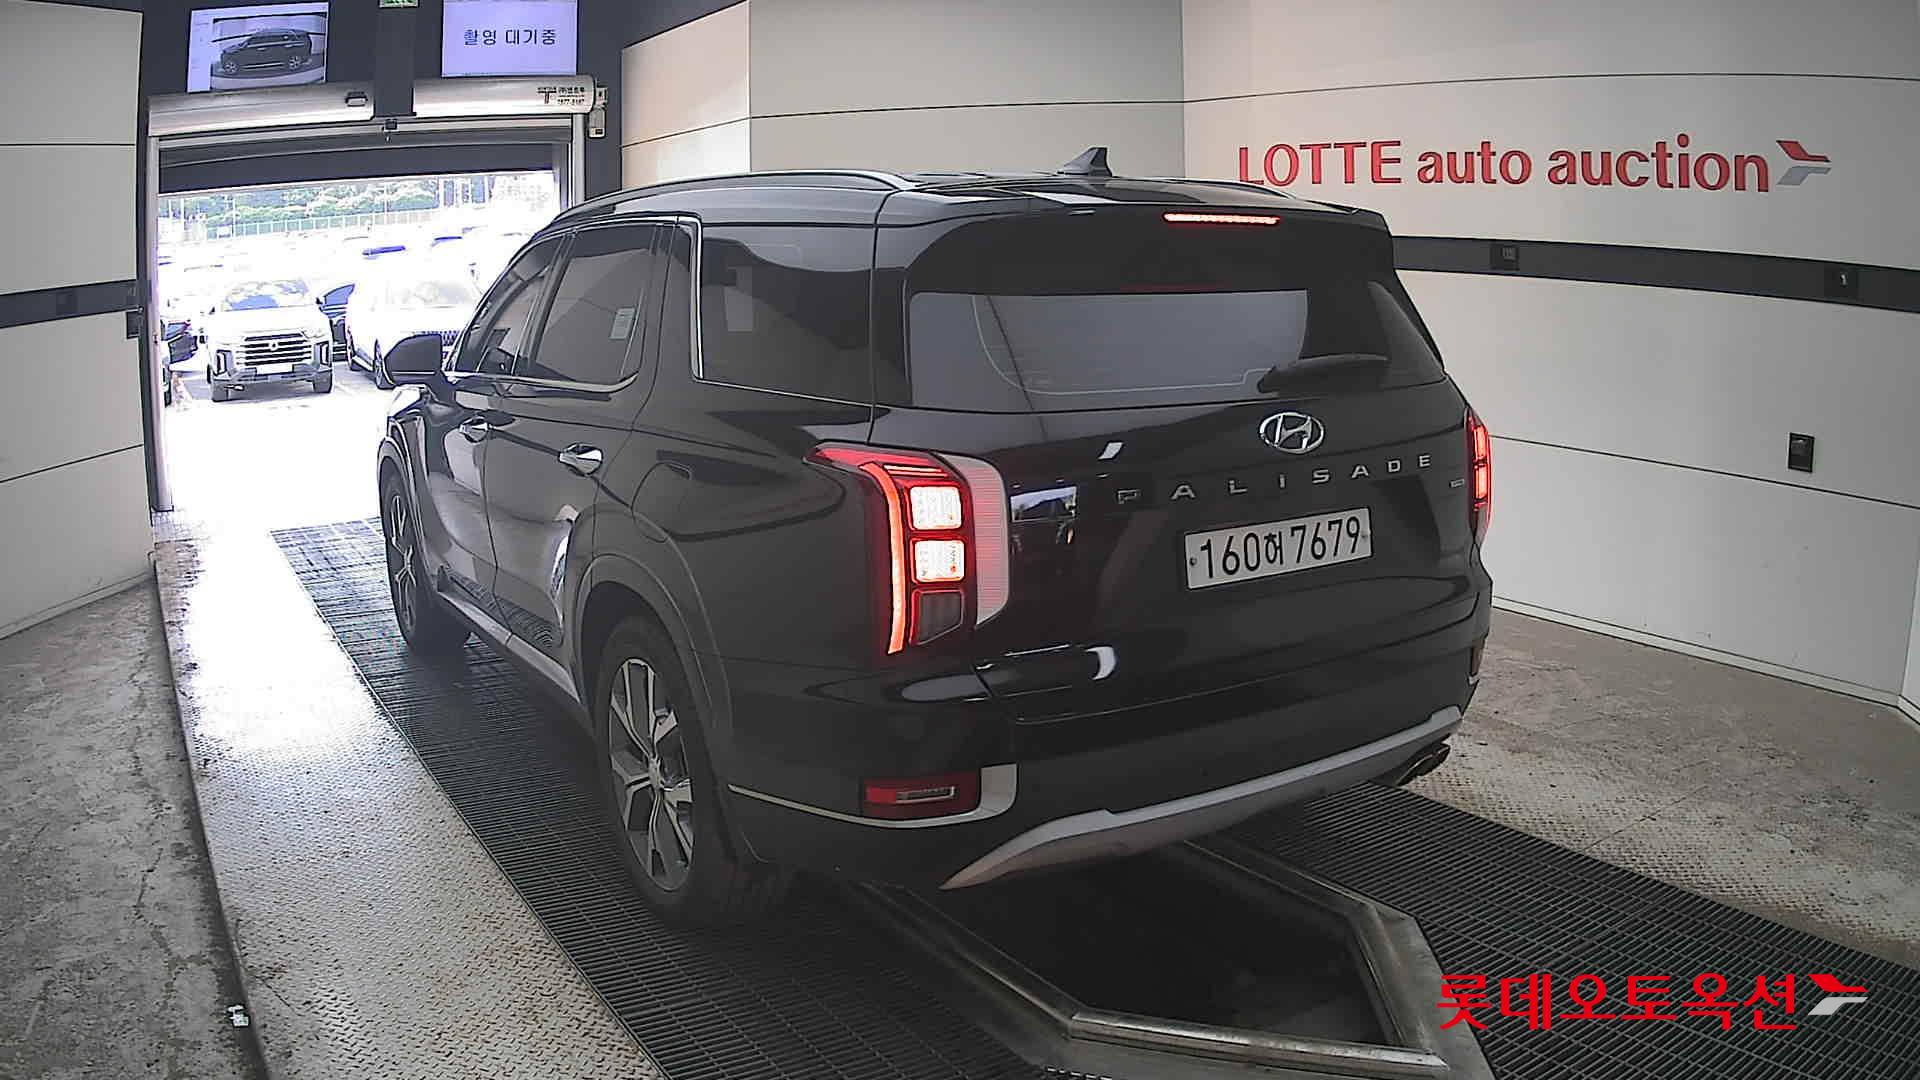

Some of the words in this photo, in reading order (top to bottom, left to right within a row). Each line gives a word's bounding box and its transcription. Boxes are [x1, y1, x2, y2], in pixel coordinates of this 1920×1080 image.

[504, 28, 556, 46] 대기중
[1239, 139, 1402, 187] LOTTE
[1416, 141, 1533, 185] auto
[1547, 133, 1770, 192] auction
[1116, 454, 1432, 504] PALISADE
